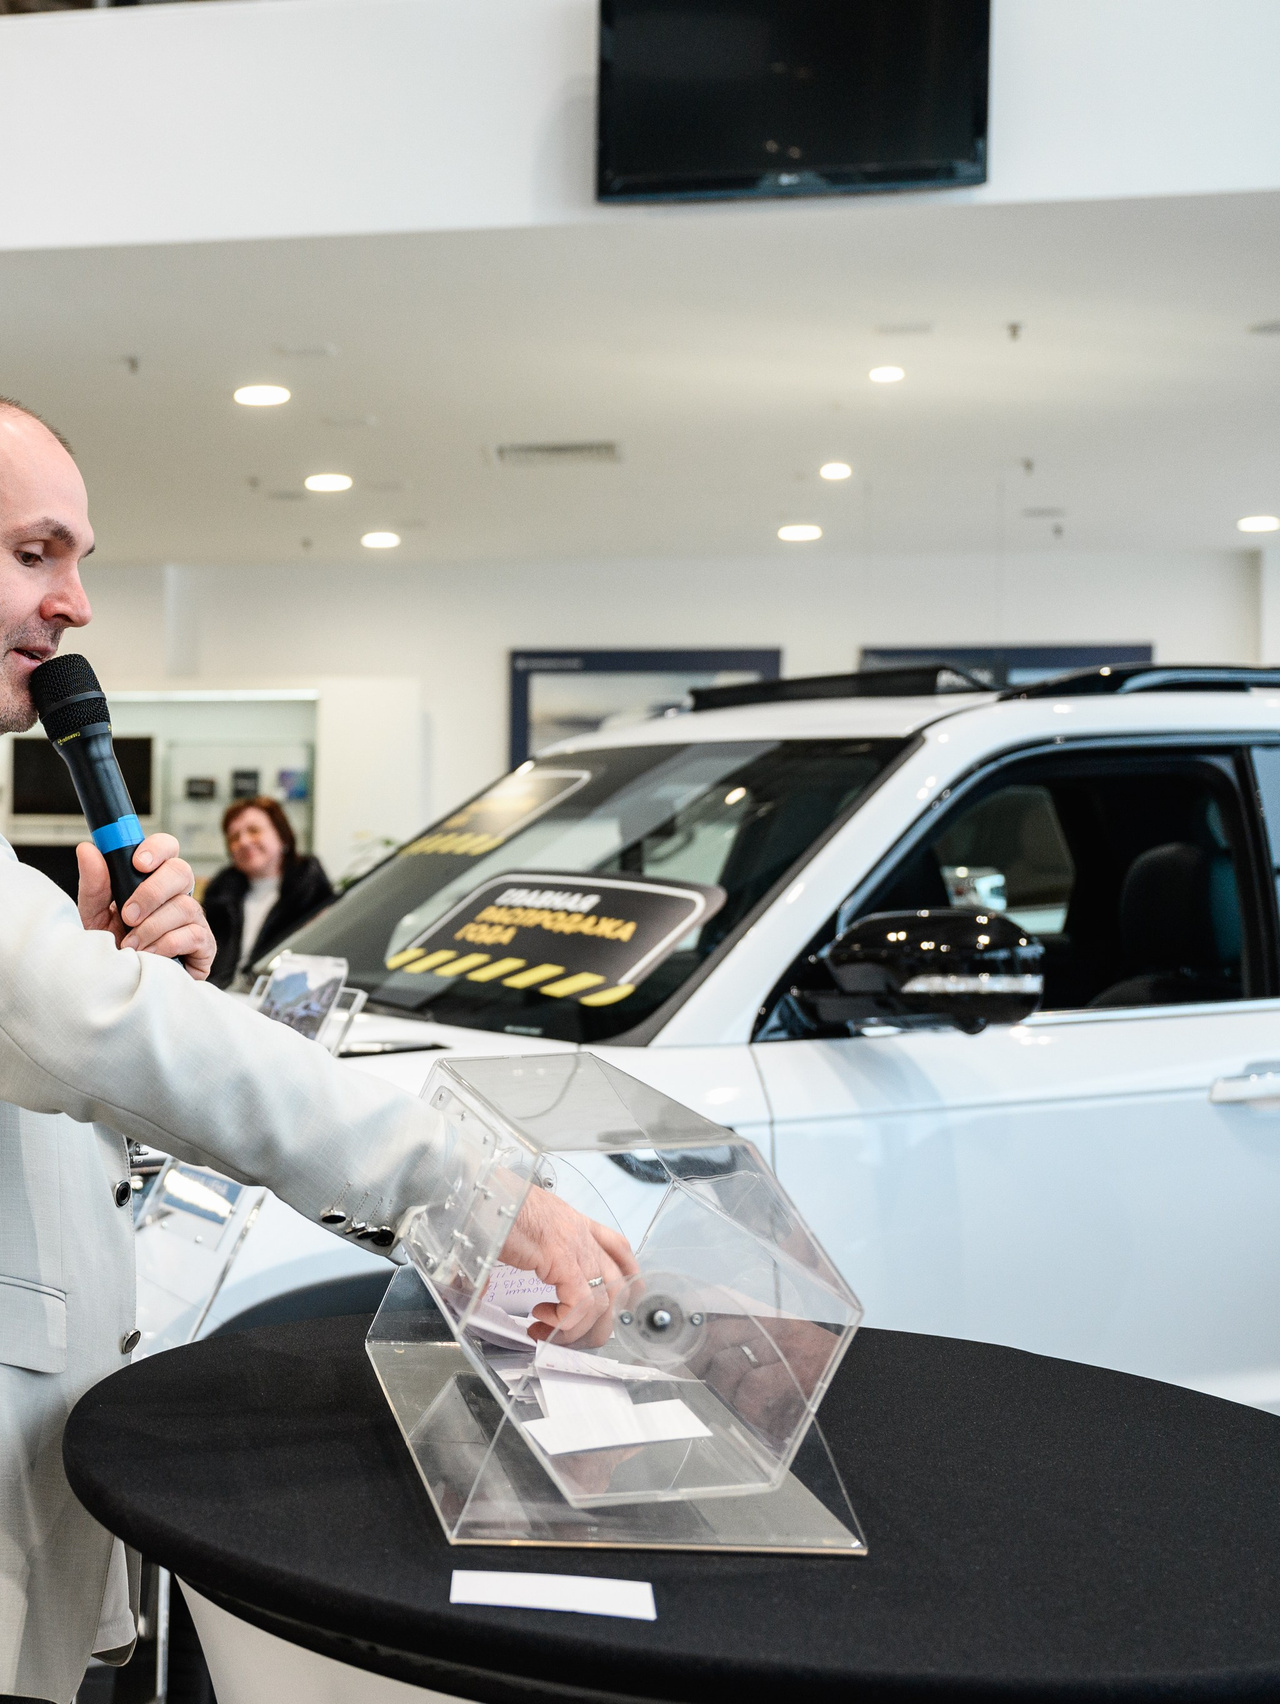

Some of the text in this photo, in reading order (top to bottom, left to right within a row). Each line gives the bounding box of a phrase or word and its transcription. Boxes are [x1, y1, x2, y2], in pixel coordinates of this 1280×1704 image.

[494, 888, 601, 913] ГЛАВНАЯ
[454, 922, 517, 945] ГОДА
[474, 905, 637, 942] РАСПРОДАЖА
